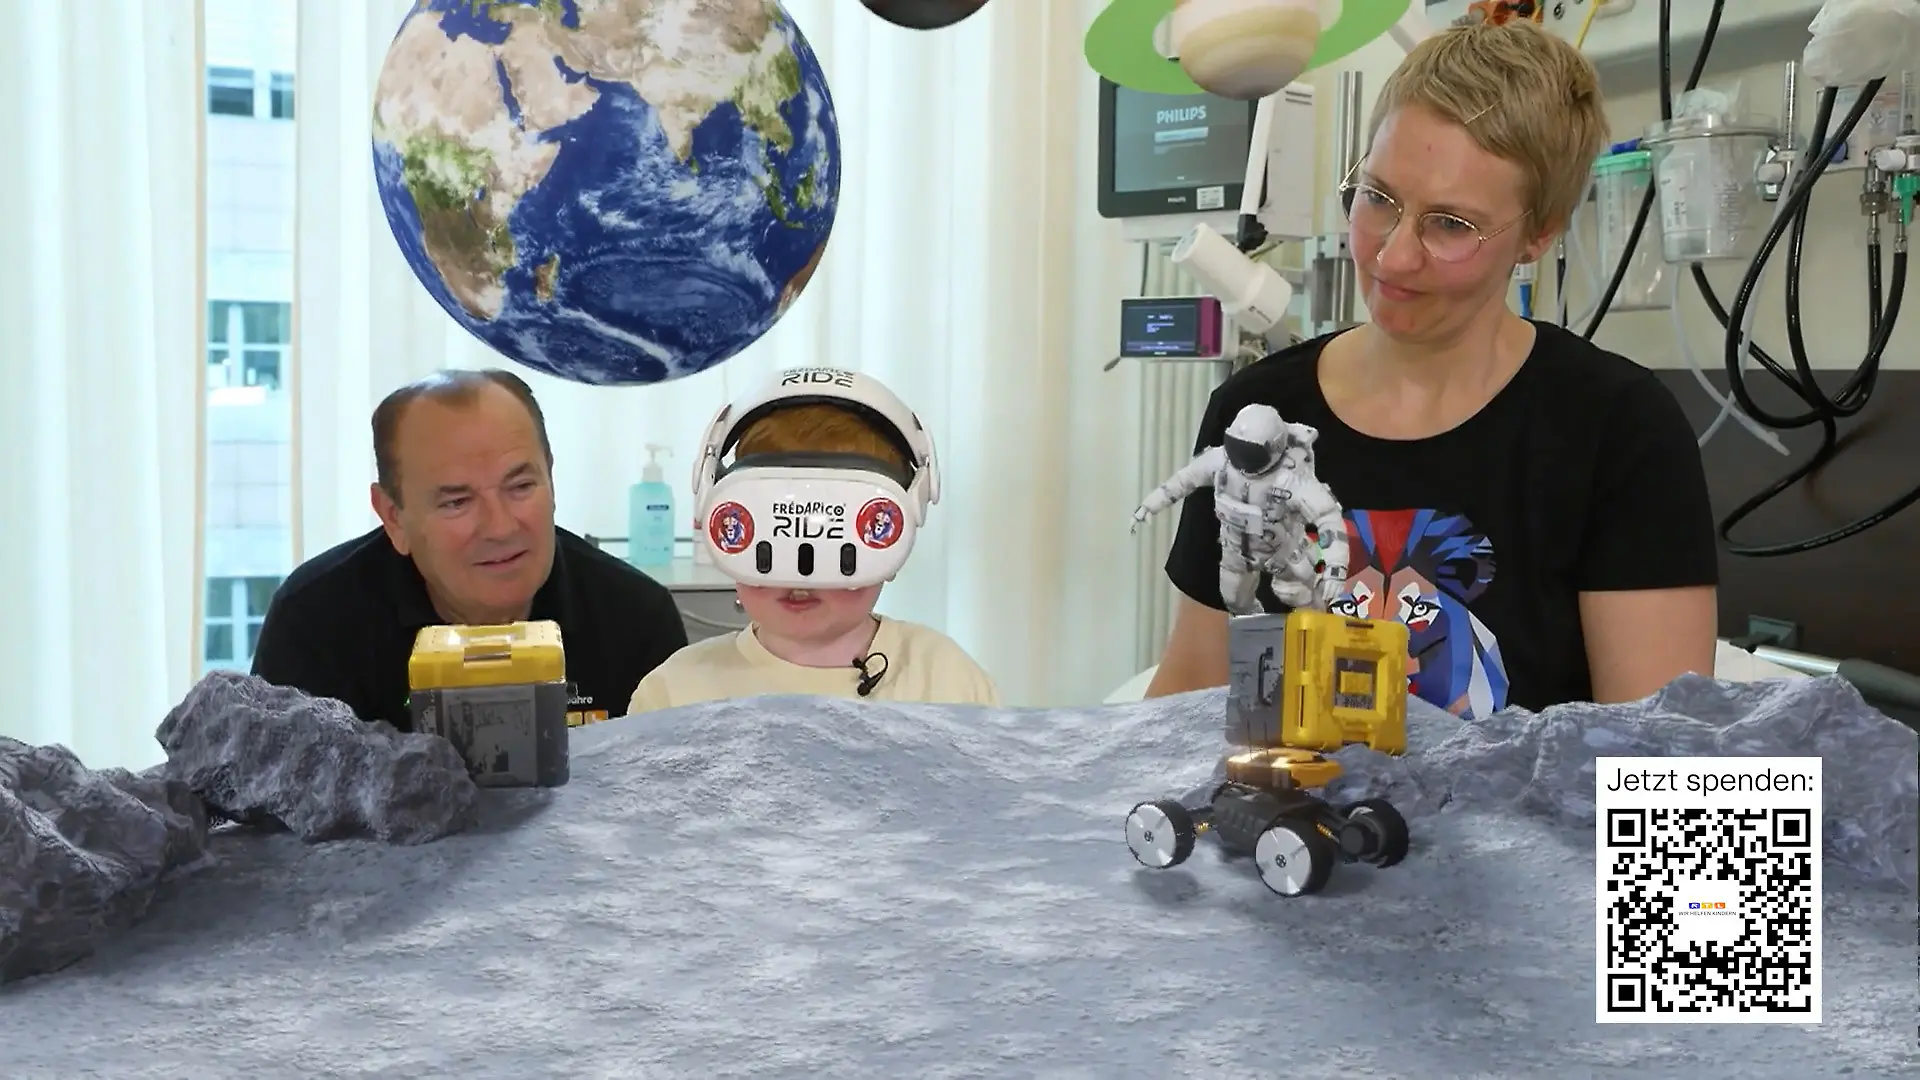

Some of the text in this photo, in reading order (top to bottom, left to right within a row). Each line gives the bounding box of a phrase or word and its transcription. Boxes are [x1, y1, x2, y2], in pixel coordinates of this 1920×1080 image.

[1156, 105, 1207, 124] PHILIPS
[781, 372, 853, 388] RIDE
[773, 516, 844, 538] RIDE
